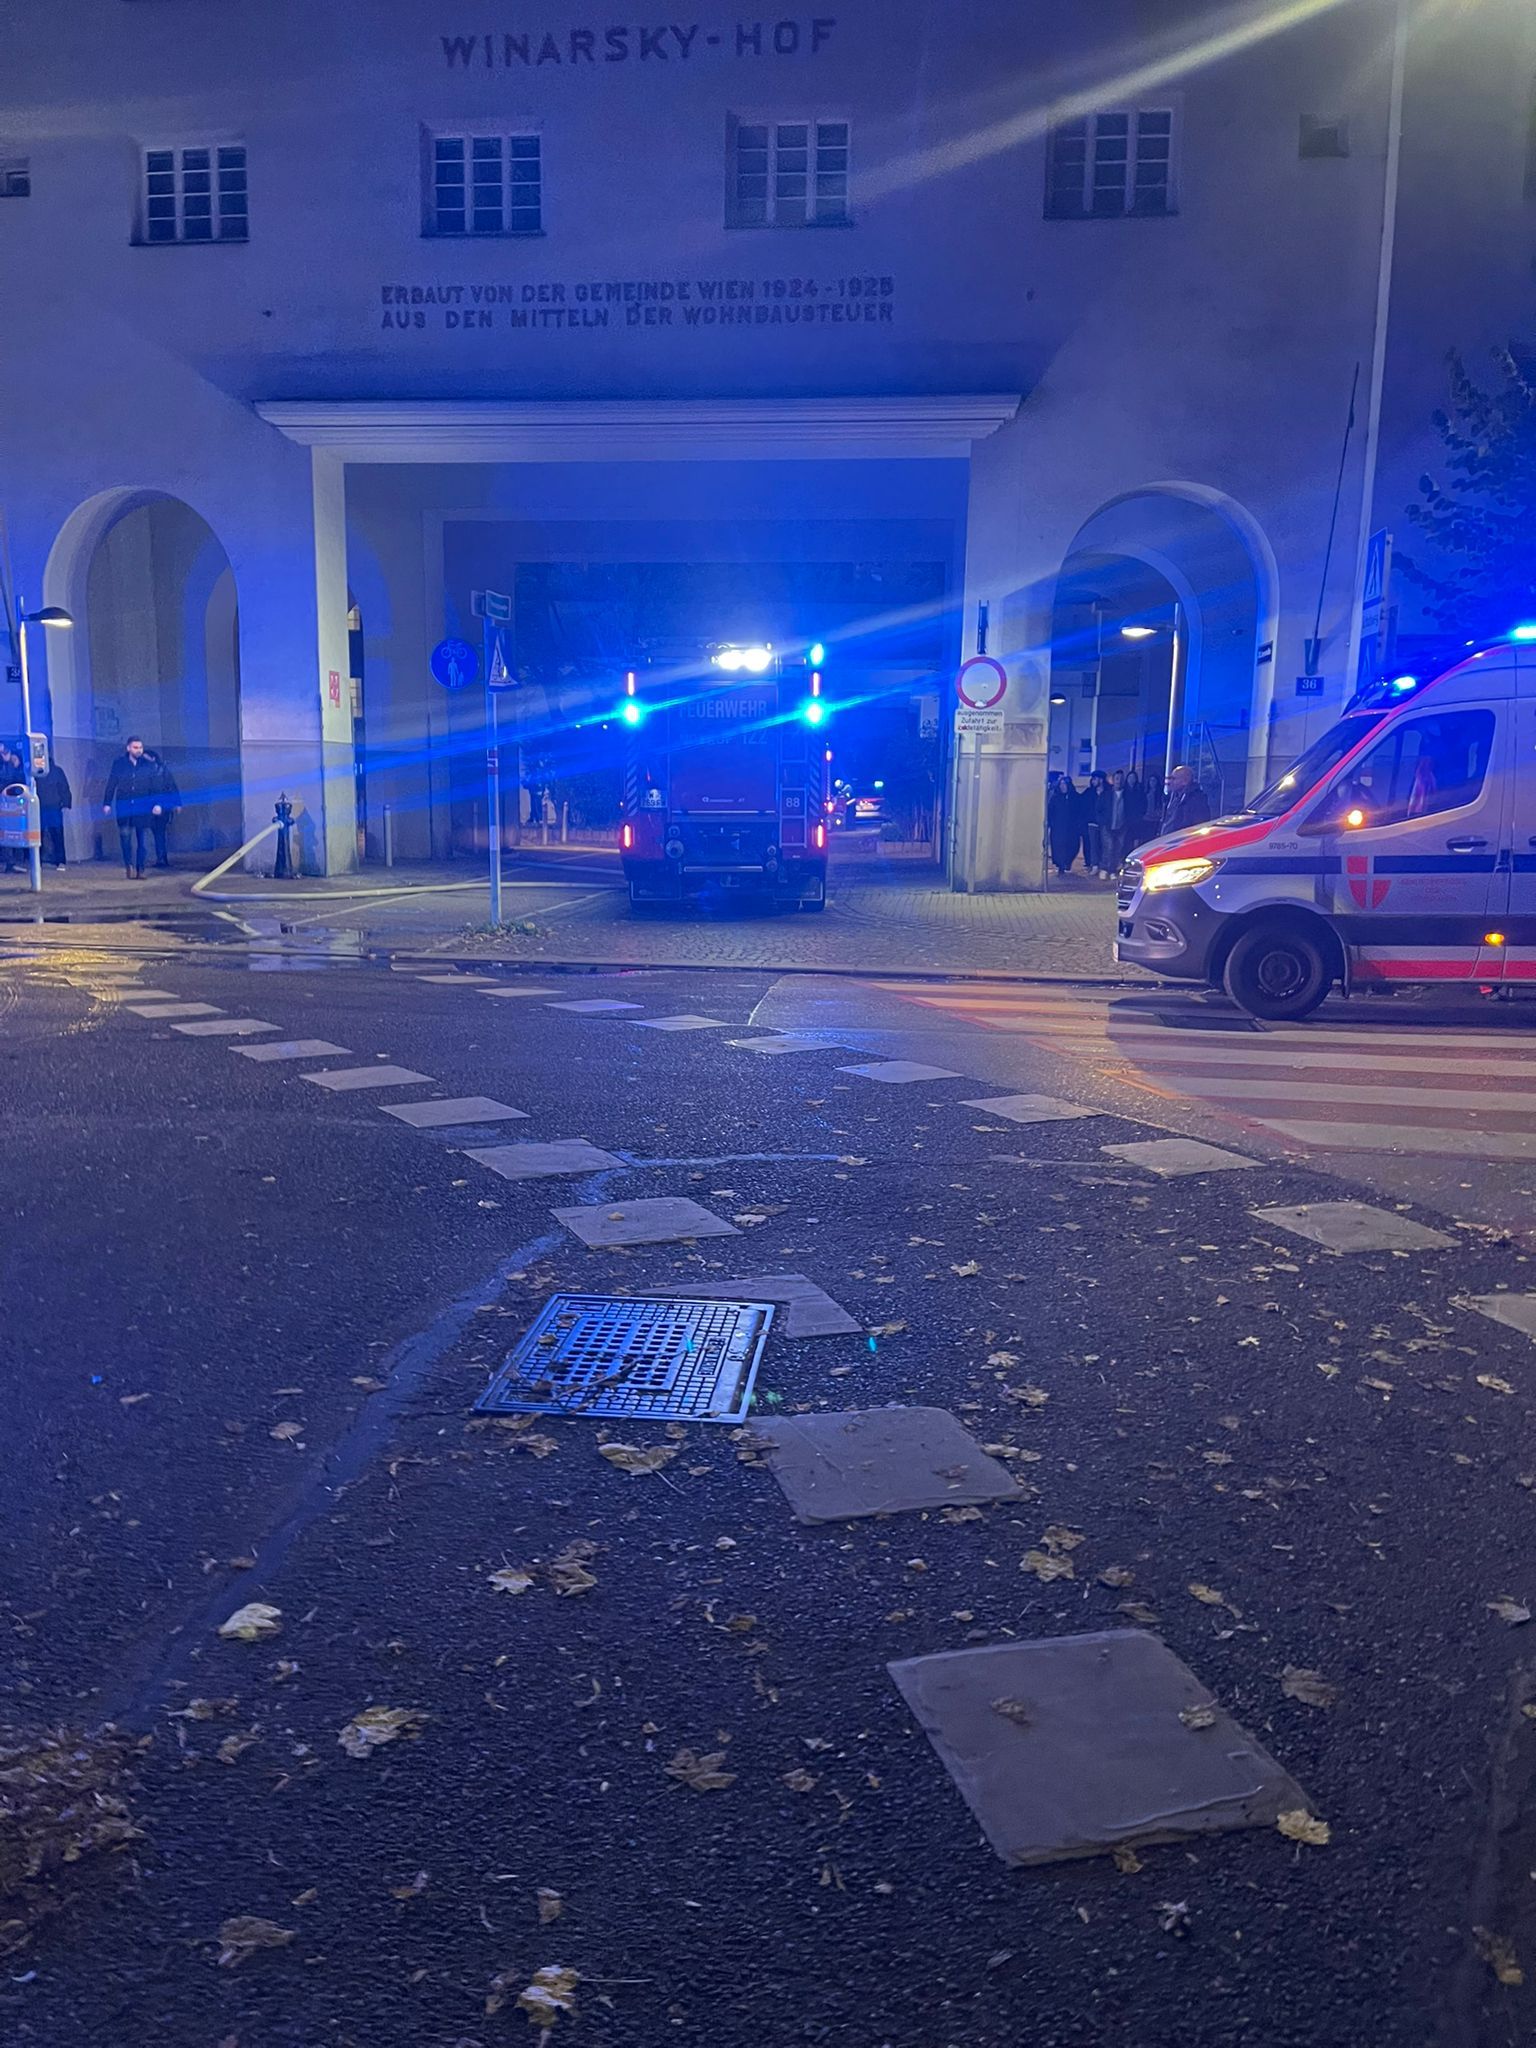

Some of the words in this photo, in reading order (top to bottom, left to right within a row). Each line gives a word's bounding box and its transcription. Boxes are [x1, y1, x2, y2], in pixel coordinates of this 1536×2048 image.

[440, 18, 837, 69] WINARSKY-HOF
[381, 285, 464, 305] ERBAUT
[470, 284, 514, 304] VON
[521, 283, 566, 302] DER
[574, 281, 691, 303] GEMEINDE
[698, 279, 754, 300] WIEN
[381, 310, 426, 329] AUS
[445, 309, 493, 329] DEN
[511, 308, 609, 328] MITTELN
[626, 303, 673, 326] DER
[683, 302, 893, 326] WOHNBAUSTEUER
[1302, 678, 1317, 689] 36
[679, 699, 767, 719] FEUERWEHR
[785, 797, 800, 807] 88
